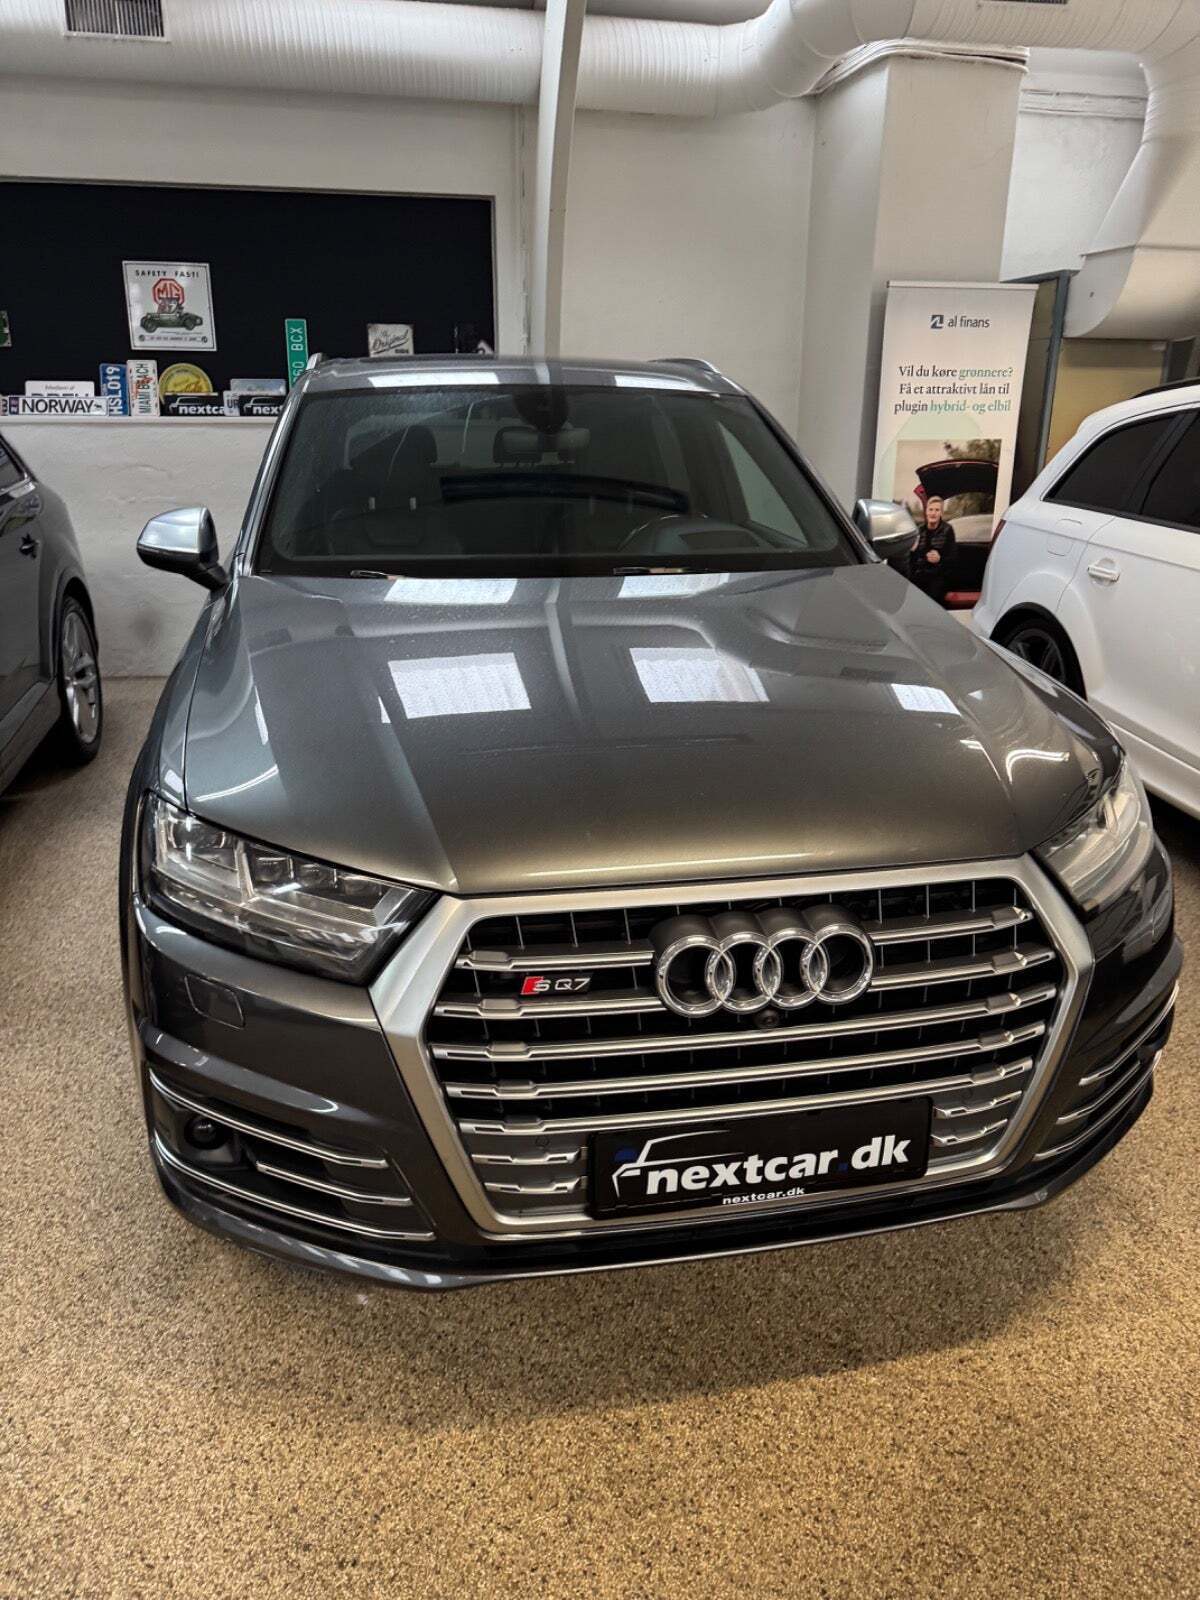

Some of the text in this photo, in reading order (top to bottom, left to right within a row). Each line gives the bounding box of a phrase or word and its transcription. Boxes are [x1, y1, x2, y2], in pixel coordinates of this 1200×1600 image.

[135, 269, 167, 277] SAFETY
[947, 315, 990, 328] al finans
[289, 327, 303, 351] BCX
[899, 365, 914, 377] Vil
[916, 366, 930, 377] du
[932, 365, 958, 377] køre
[899, 383, 1010, 395] Få et attraktivt lån til
[22, 399, 94, 413] NORWAY
[894, 400, 928, 415] plugin
[972, 404, 986, 415] og
[988, 400, 1011, 412] elbil
[722, 1186, 806, 1206] nextcar.dk
